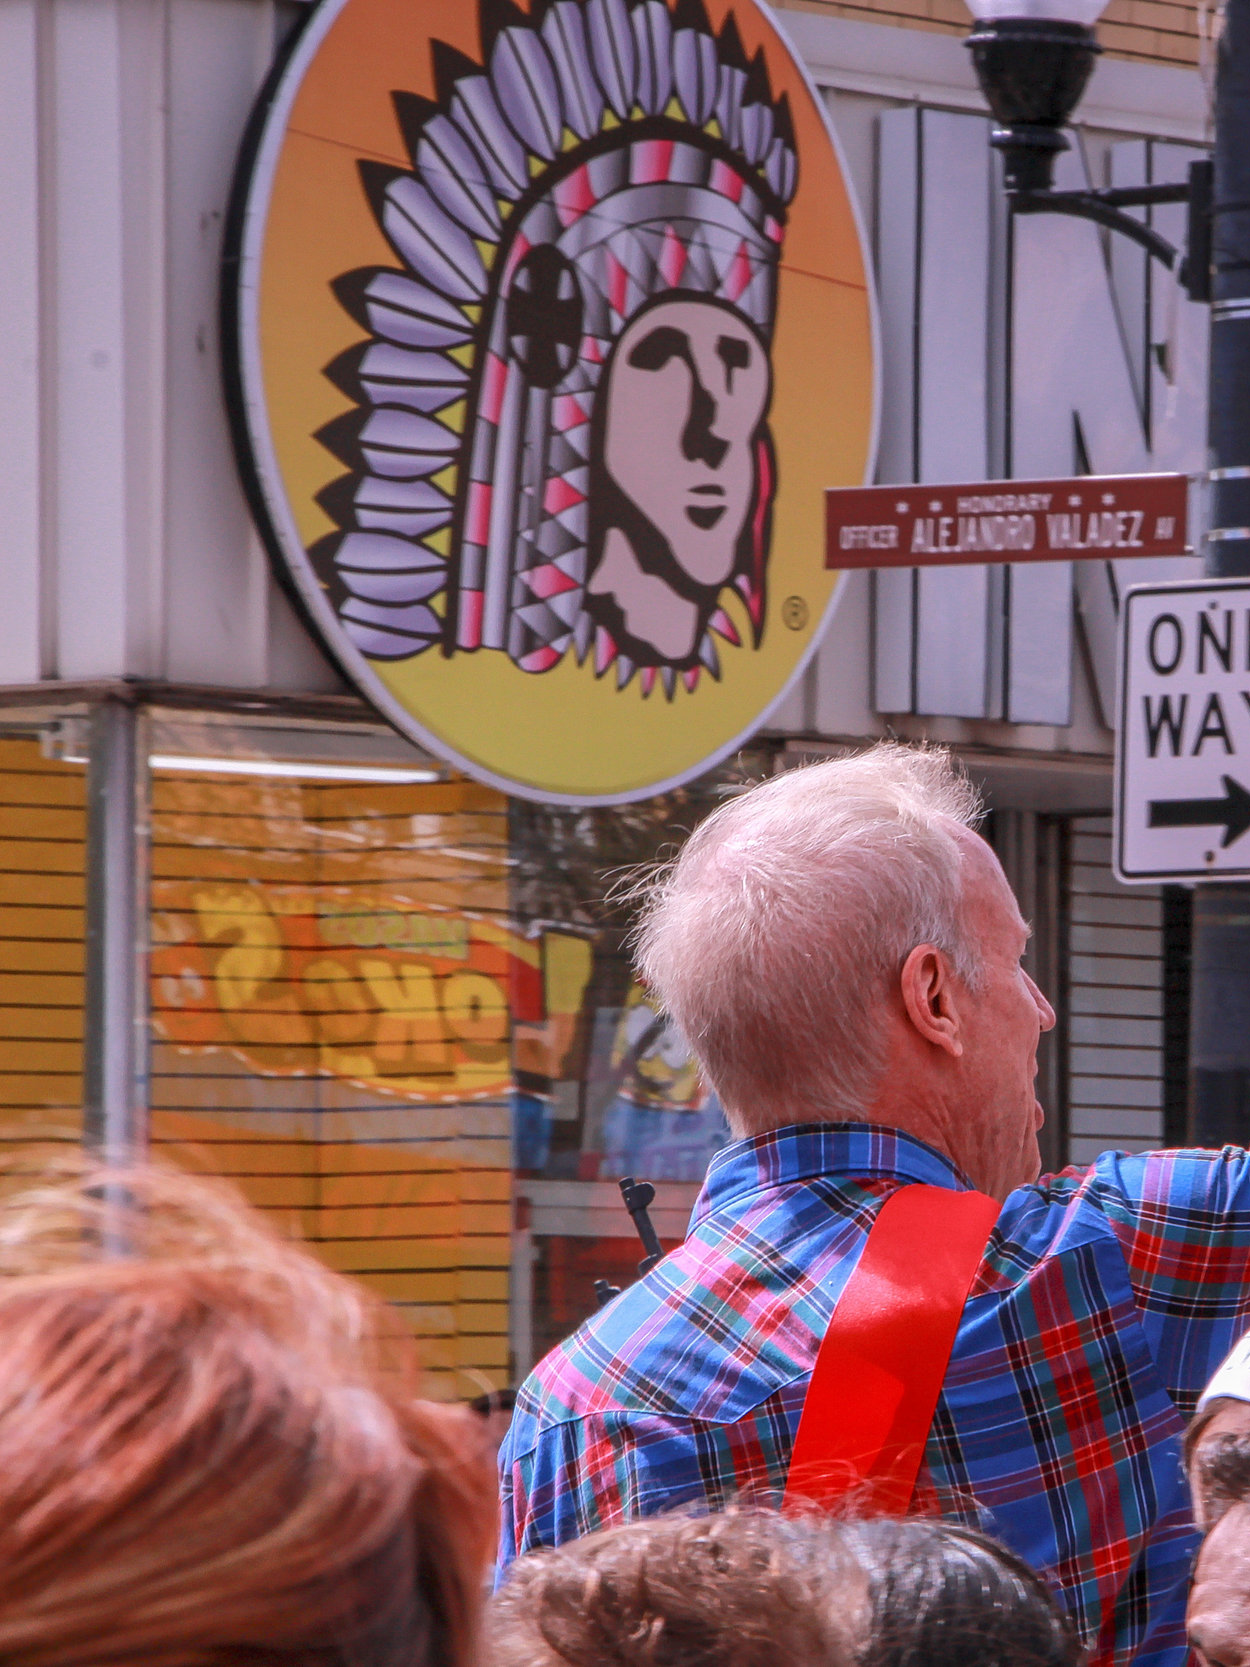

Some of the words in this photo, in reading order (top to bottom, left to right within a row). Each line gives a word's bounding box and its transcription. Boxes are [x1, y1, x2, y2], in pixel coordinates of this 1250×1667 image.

[957, 493, 1053, 514] HONORARY
[839, 525, 899, 550] OFFICER
[910, 514, 1036, 554] ALEJANDRO
[1046, 510, 1144, 549] VALADEZ
